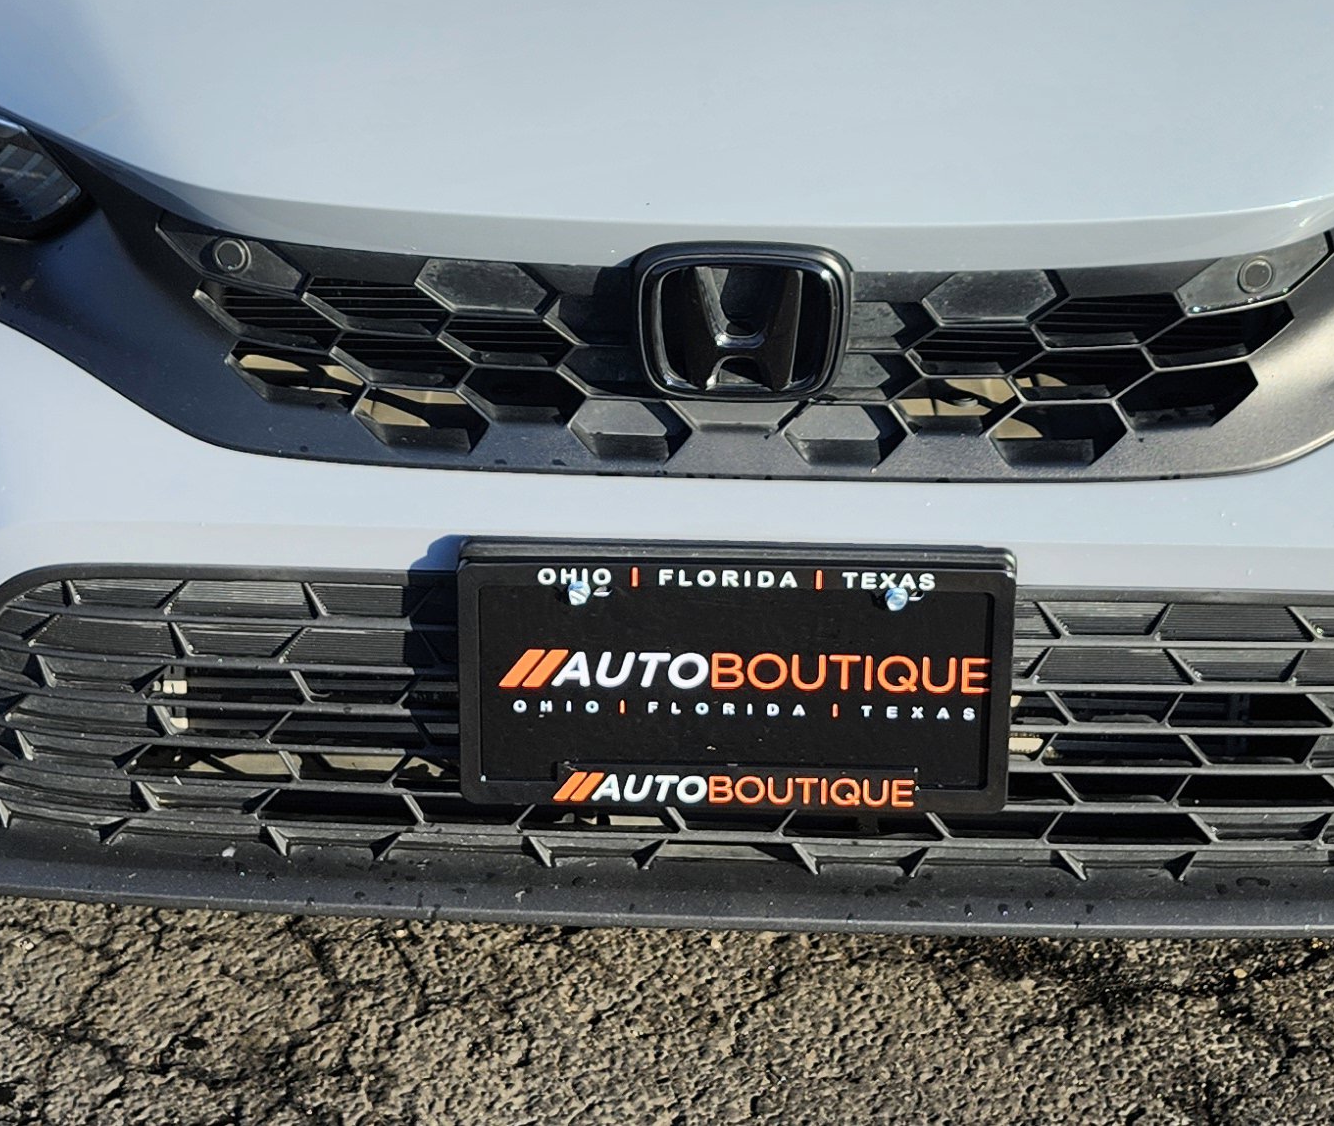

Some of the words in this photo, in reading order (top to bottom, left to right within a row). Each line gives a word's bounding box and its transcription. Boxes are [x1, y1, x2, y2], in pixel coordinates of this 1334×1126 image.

[536, 568, 612, 586] OHIO
[658, 569, 798, 588] FLORIDA
[842, 572, 936, 590] TEXAS
[512, 699, 600, 714] OHIO
[647, 700, 806, 717] FLORIDA
[861, 704, 976, 721] TEXAS
